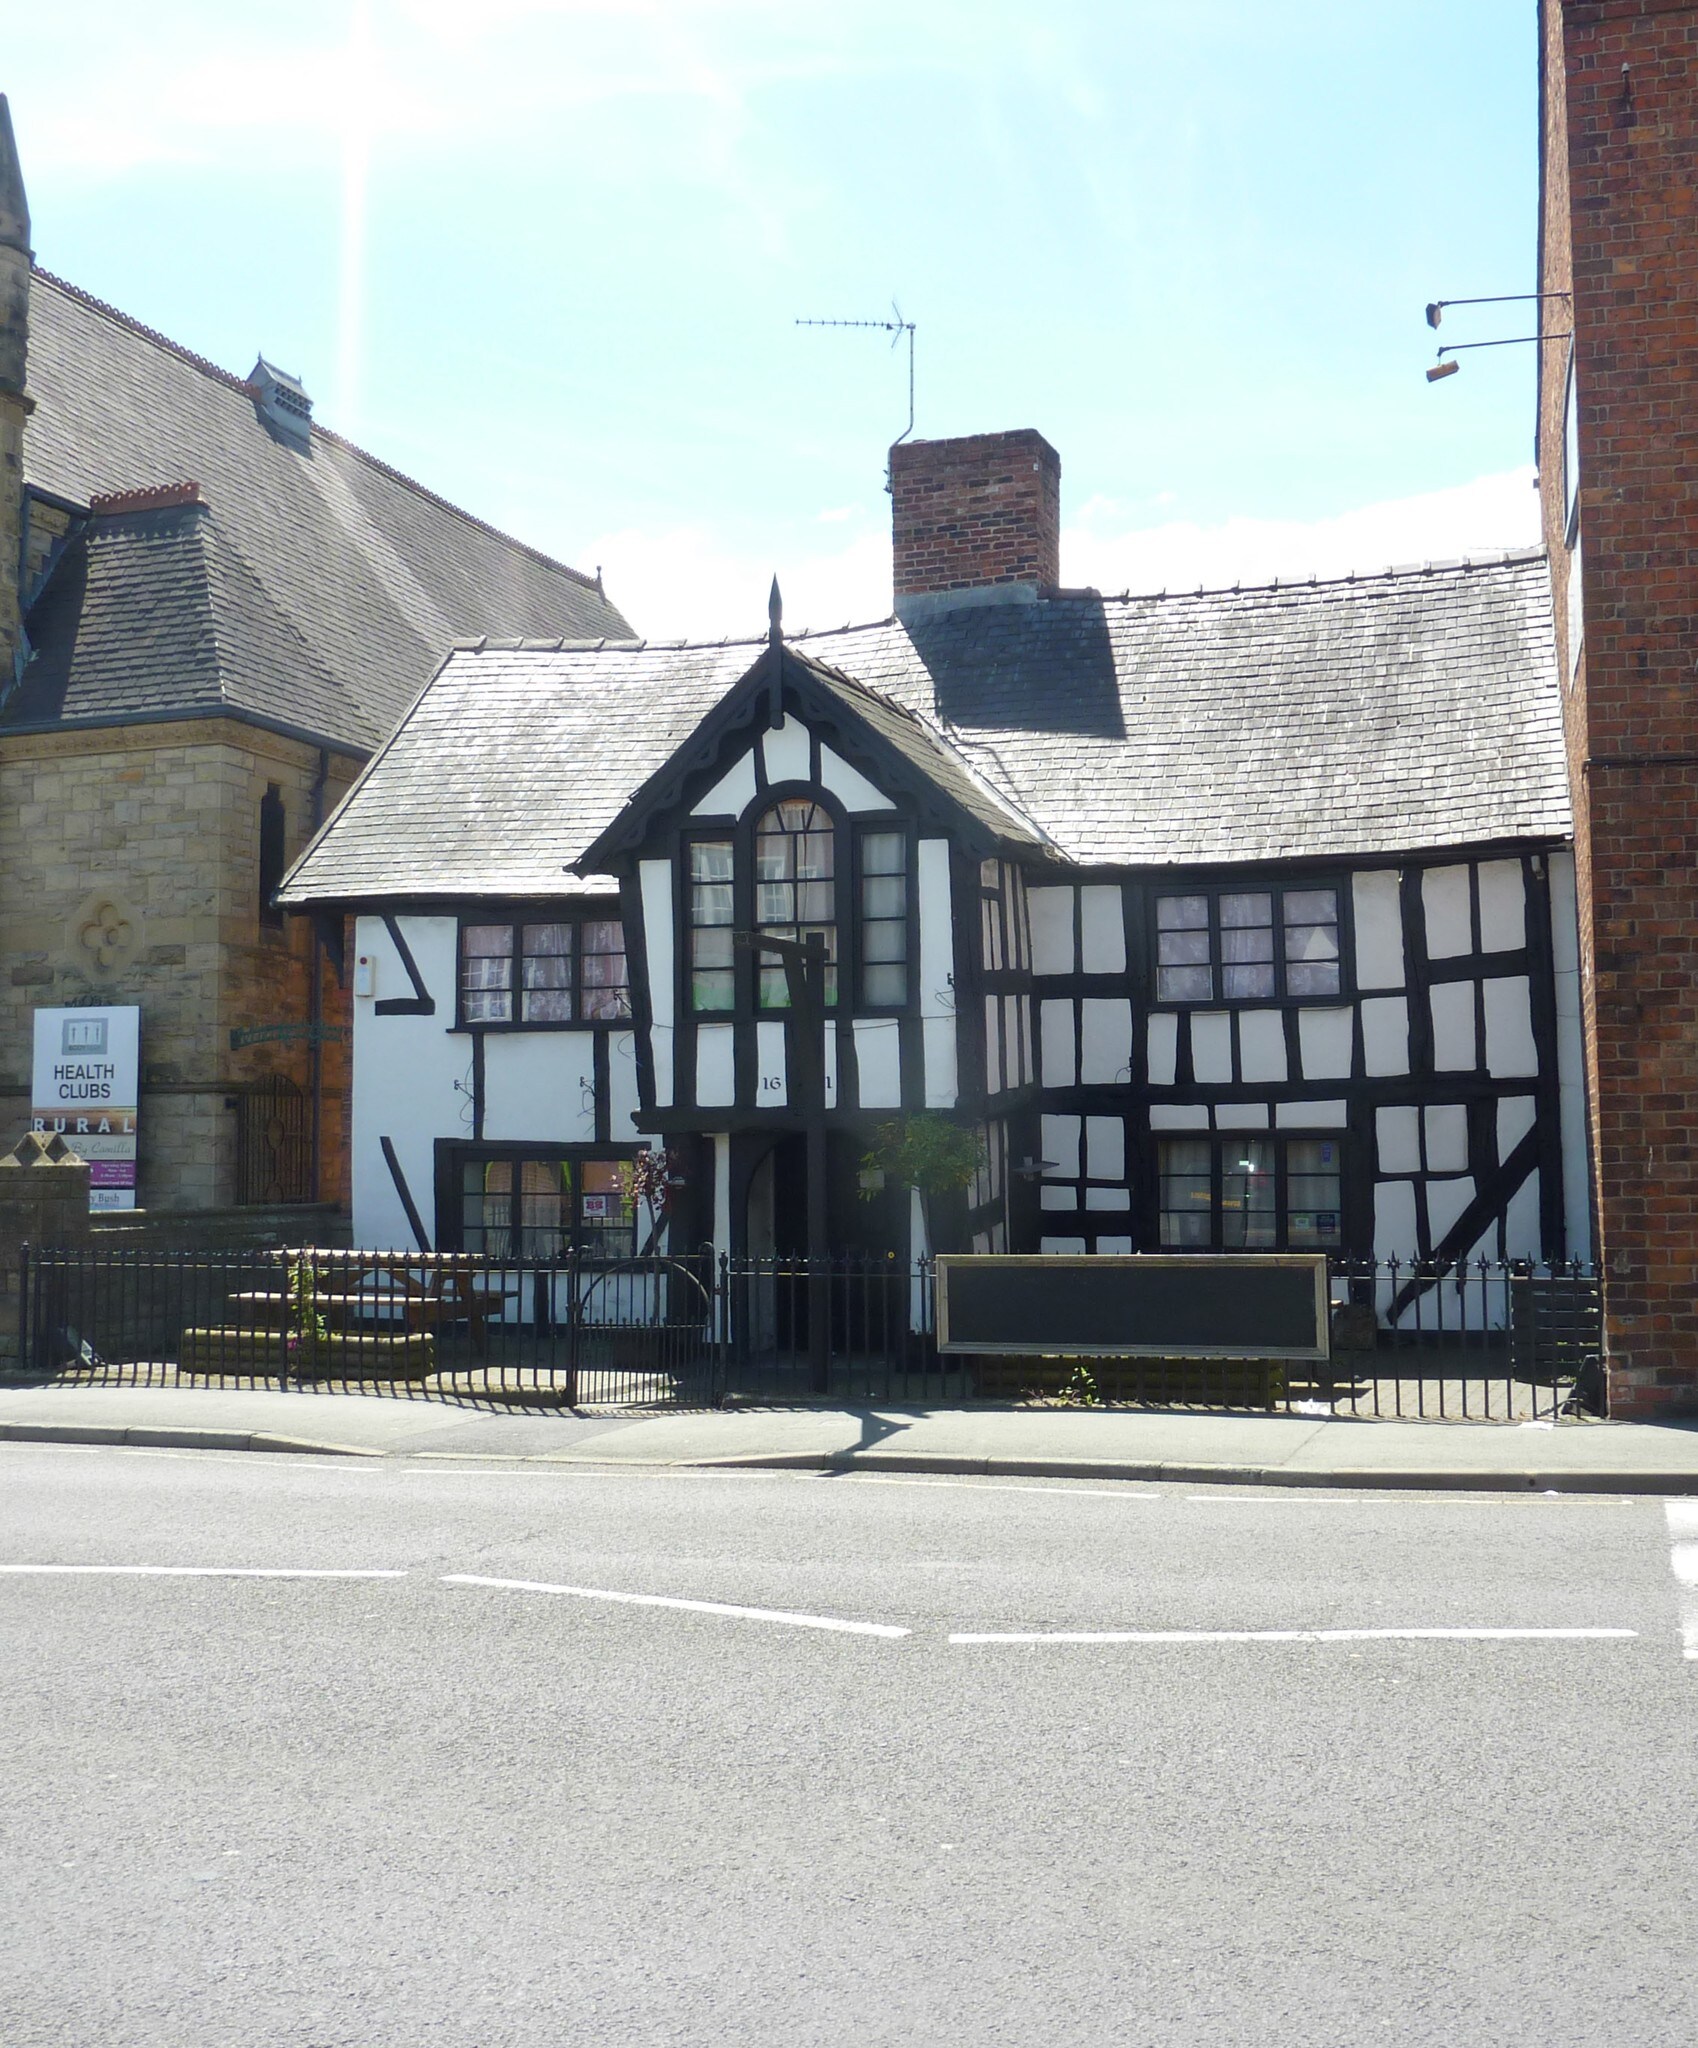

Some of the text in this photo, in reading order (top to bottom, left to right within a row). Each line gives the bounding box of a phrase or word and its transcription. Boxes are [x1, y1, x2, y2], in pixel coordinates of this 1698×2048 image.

[54, 1064, 114, 1079] HEALTH
[59, 1083, 111, 1099] CLUBS
[763, 1077, 781, 1090] 16
[34, 1117, 134, 1133] RURAL
